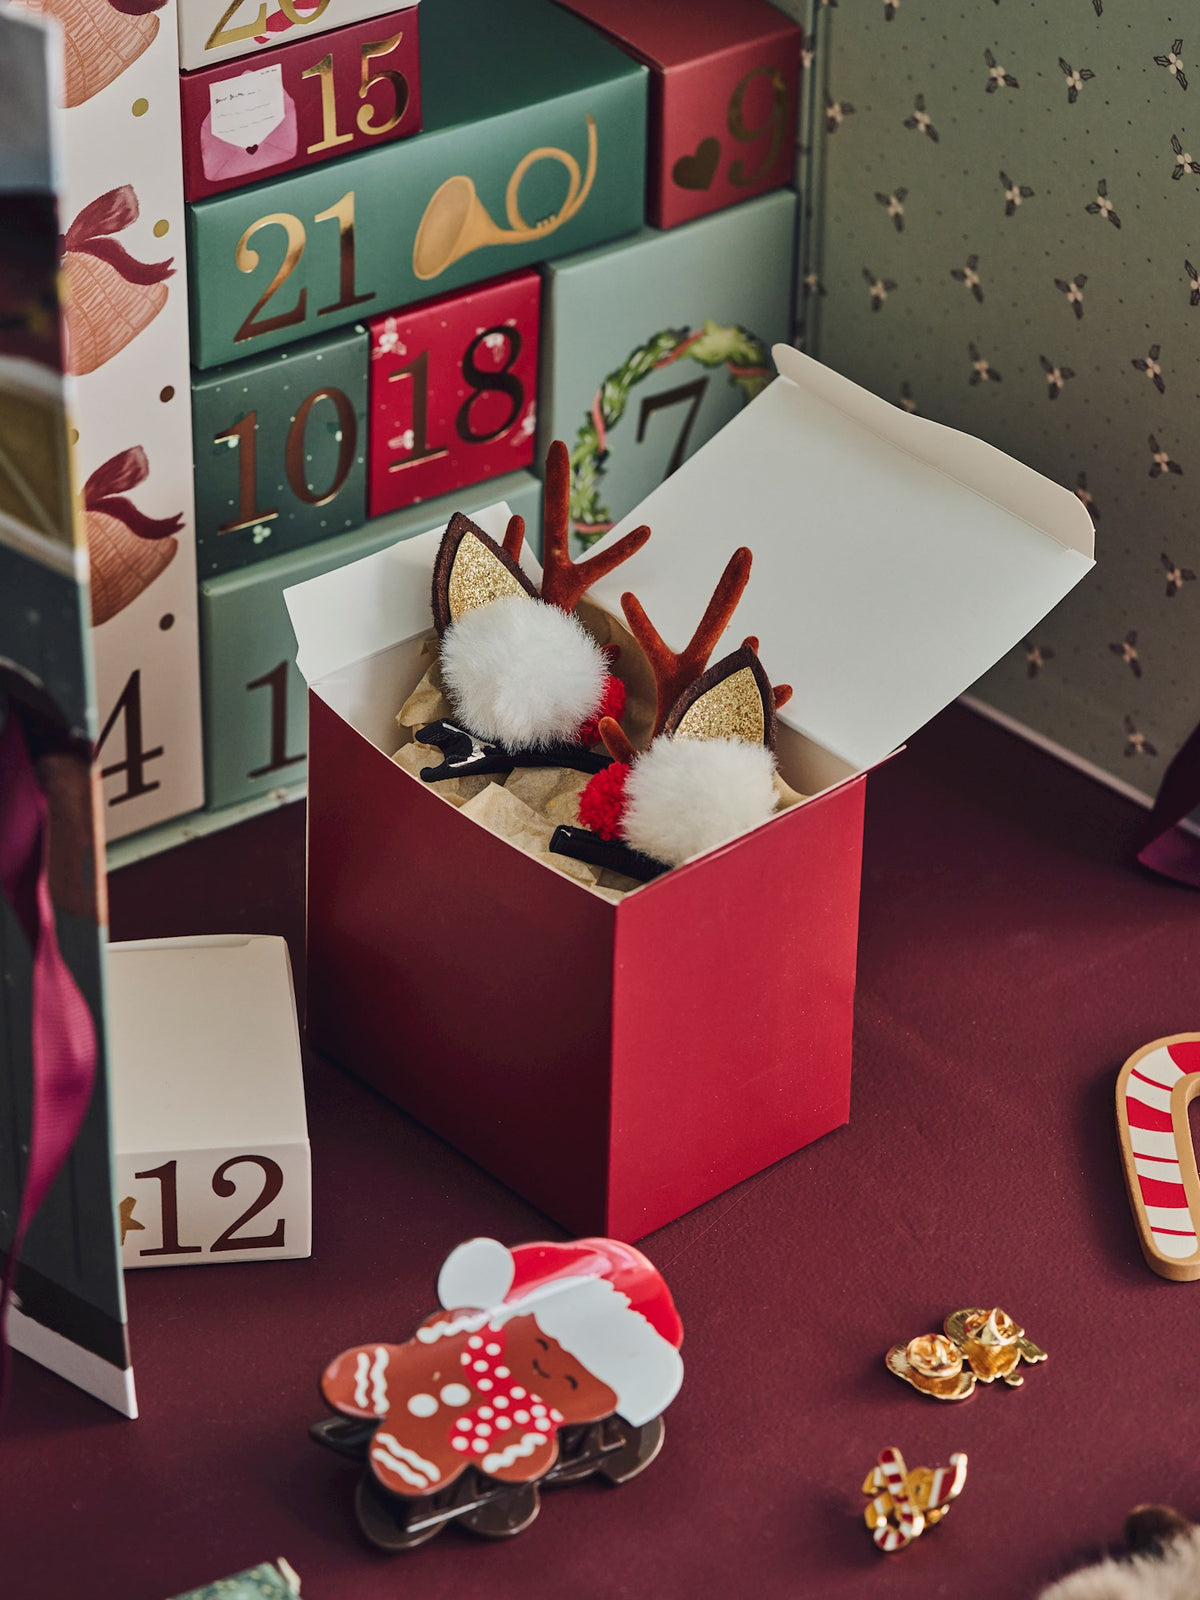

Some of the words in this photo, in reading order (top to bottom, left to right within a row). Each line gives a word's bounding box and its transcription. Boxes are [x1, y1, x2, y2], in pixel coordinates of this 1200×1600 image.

[205, 0, 331, 50] 2
[302, 32, 408, 154] 15
[727, 66, 790, 186] 9
[234, 191, 376, 343] 21
[388, 325, 524, 473] 18
[636, 376, 709, 479] 7
[214, 387, 357, 535] 10
[135, 1155, 285, 1256] 12
